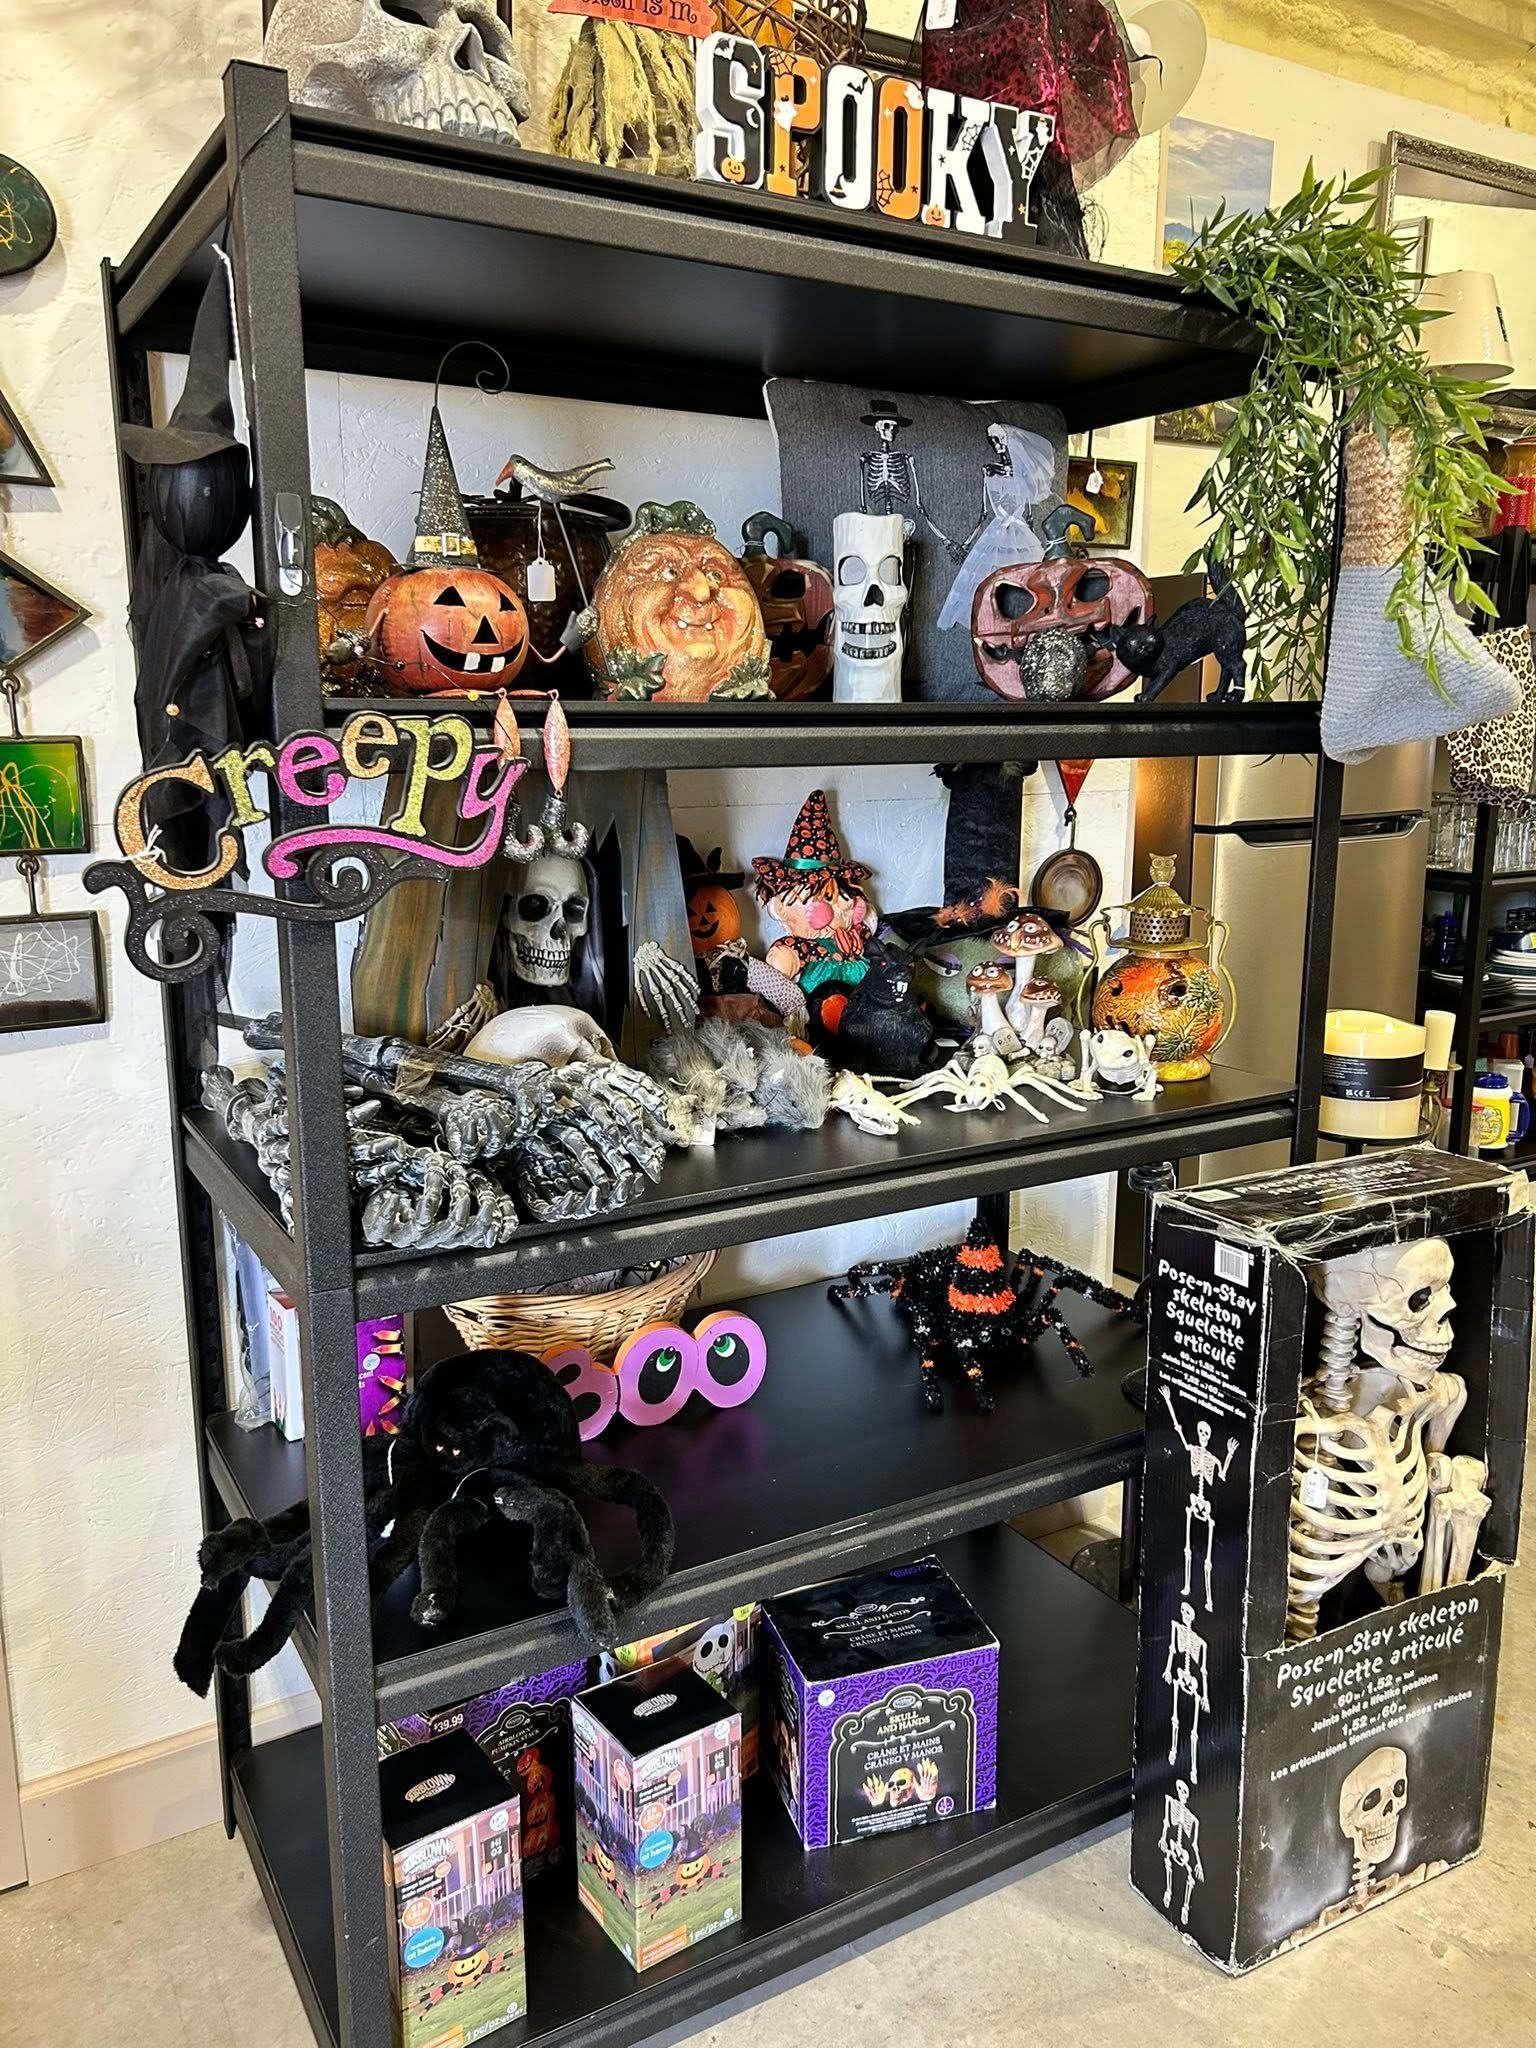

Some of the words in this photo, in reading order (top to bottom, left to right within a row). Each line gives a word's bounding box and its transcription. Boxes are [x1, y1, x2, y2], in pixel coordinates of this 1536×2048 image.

[696, 31, 1056, 244] SPOOKY
[115, 711, 531, 891] Creepy
[1157, 1258, 1257, 1316] Pose-n-Stay
[1165, 1300, 1245, 1351] Squelette
[1172, 1287, 1242, 1330] skeleton
[1173, 1330, 1236, 1370] articulé
[835, 1617, 863, 1630] SKULL
[863, 1613, 882, 1624] AND
[882, 1608, 911, 1620] HANDS
[890, 1623, 916, 1634] MAINS
[891, 1628, 922, 1640] MANOS
[950, 1652, 992, 1671] 0565711
[1277, 1626, 1394, 1689] Pose-n-Stay
[1398, 1597, 1479, 1637] skeleton
[1290, 1656, 1384, 1708] Squelette
[1390, 1621, 1464, 1666] articulé
[1311, 1714, 1340, 1733] Joints
[1341, 1702, 1361, 1720] hold
[1402, 1672, 1439, 1695] position
[1337, 1691, 1353, 1708] 60
[1366, 1674, 1393, 1695] 1.52
[433, 1713, 464, 1732] $39.99
[876, 1723, 898, 1735] AND
[899, 1715, 931, 1732] HANDS
[889, 1710, 919, 1723] SKULL
[900, 1744, 912, 1754] ET
[912, 1736, 941, 1750] MAINS
[903, 1753, 909, 1762] Y
[911, 1745, 943, 1760] MANOS
[1270, 1768, 1289, 1782] Les
[1289, 1740, 1347, 1772] articulations
[1387, 1715, 1403, 1729] des
[1404, 1706, 1432, 1724] poses
[1433, 1689, 1473, 1711] réalistes
